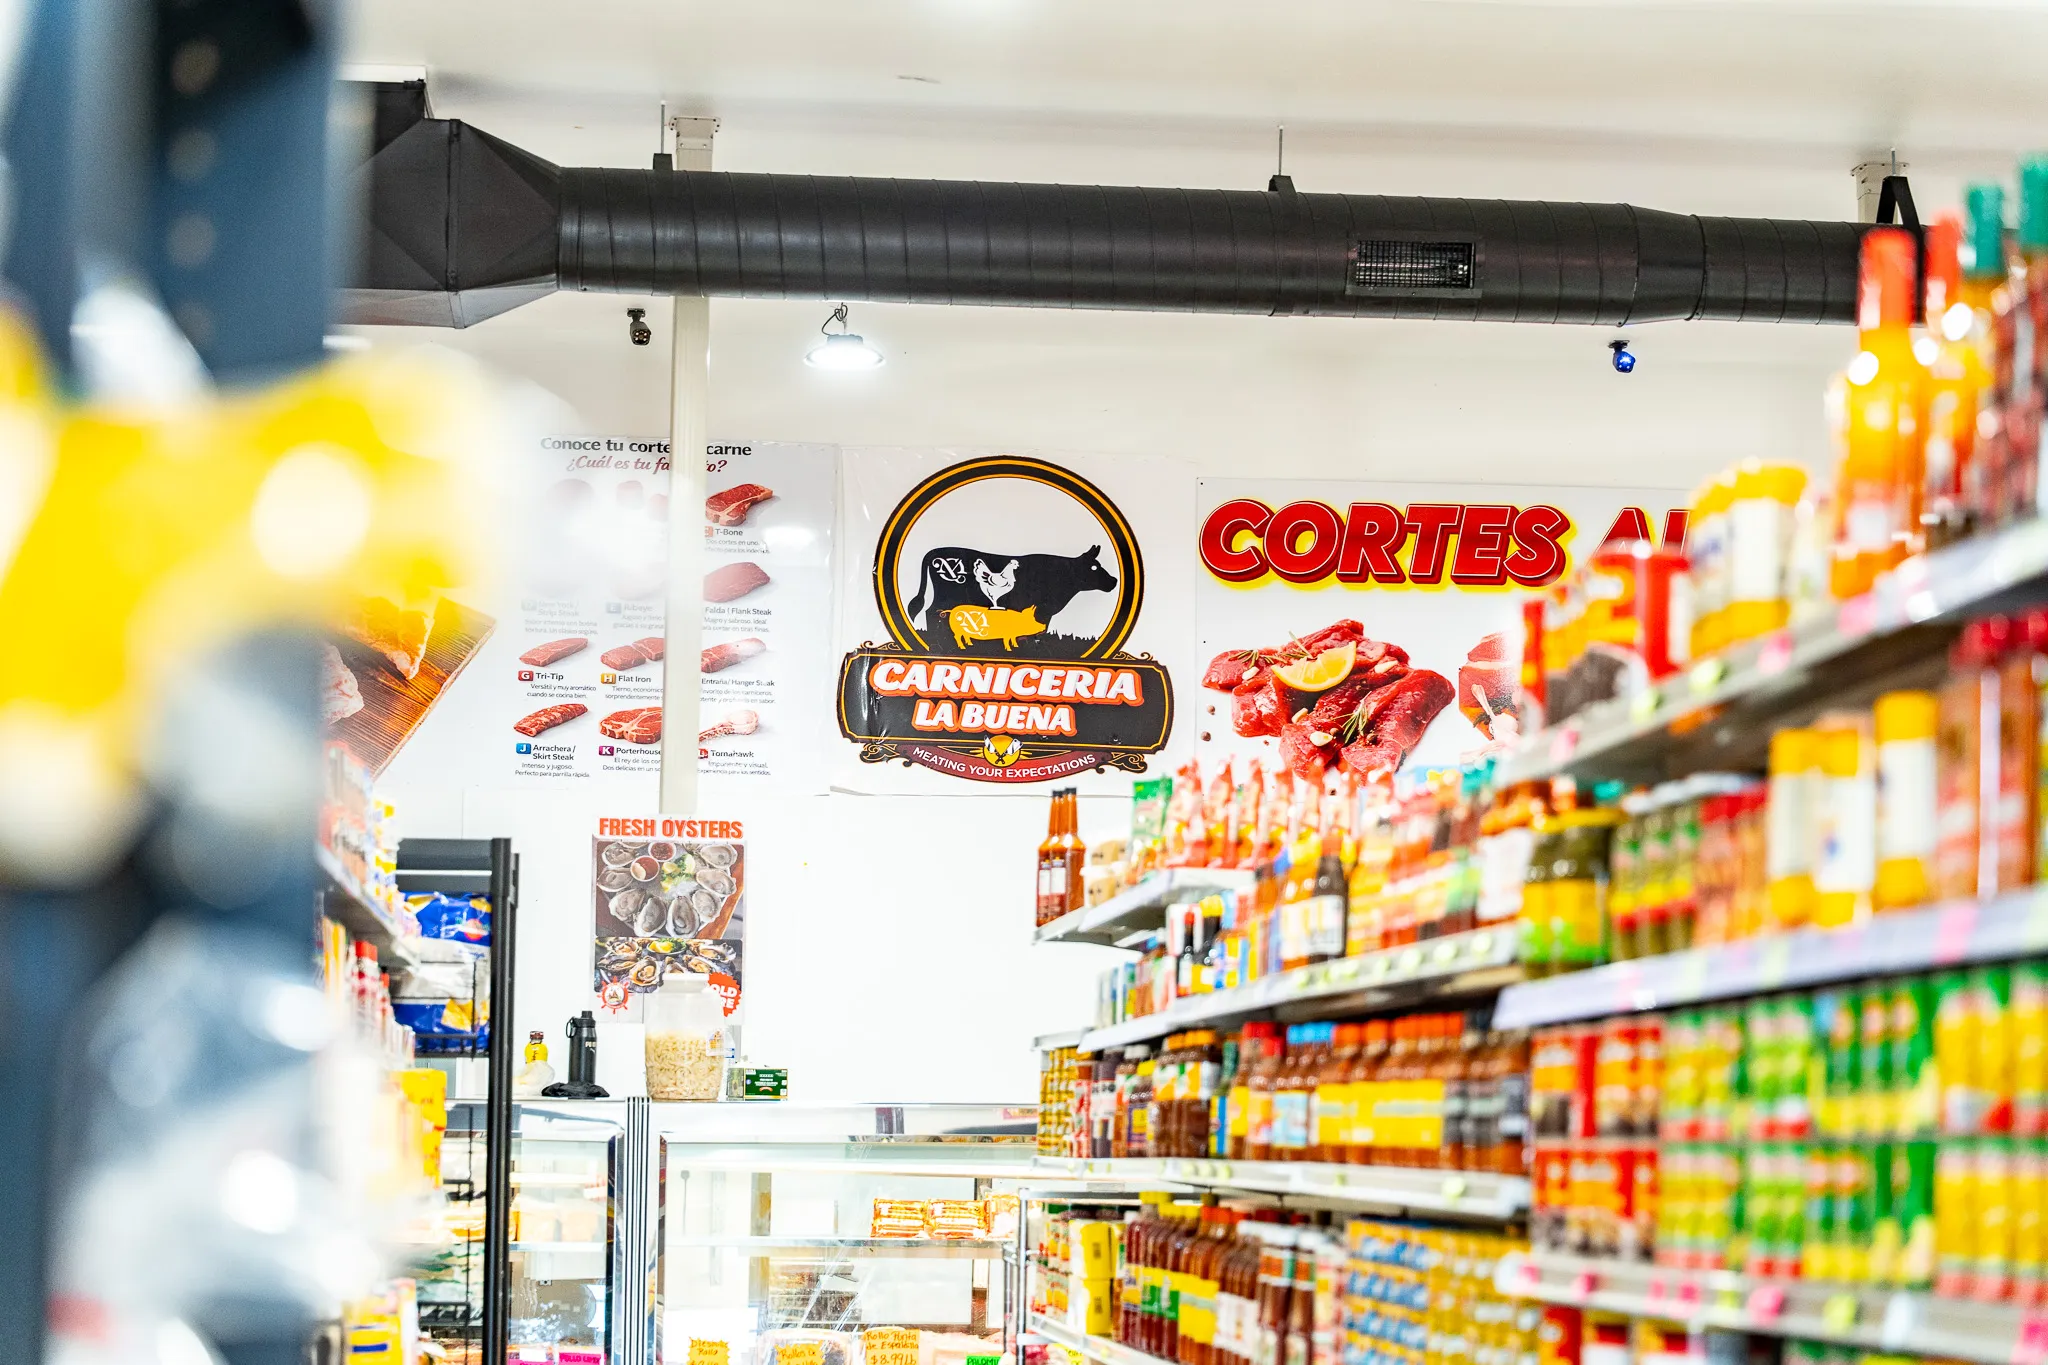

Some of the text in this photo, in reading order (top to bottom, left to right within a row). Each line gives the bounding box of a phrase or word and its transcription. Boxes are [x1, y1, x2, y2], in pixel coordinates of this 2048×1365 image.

[541, 437, 601, 450] Conoce
[605, 439, 624, 451] tu
[706, 445, 752, 456] carne
[566, 455, 613, 471] ¿Cuál
[614, 460, 630, 469] es
[634, 458, 651, 470] tu
[715, 528, 743, 536] T-Bone
[1200, 499, 1571, 587] CORTES
[752, 608, 772, 616] Steak
[521, 672, 564, 681] G Tri-Tip
[604, 674, 613, 683] H
[870, 660, 1141, 704] CARNICERIA
[731, 679, 755, 687] Hanger
[913, 698, 1075, 735] LA BUENA
[520, 744, 527, 752] J
[602, 746, 612, 755] K
[711, 750, 754, 758] Tomahawk
[912, 747, 1096, 778] MEATING YOUR EXPECTATIONS
[599, 818, 744, 840] FRESH OYSTERS
[710, 984, 738, 999] OLD
